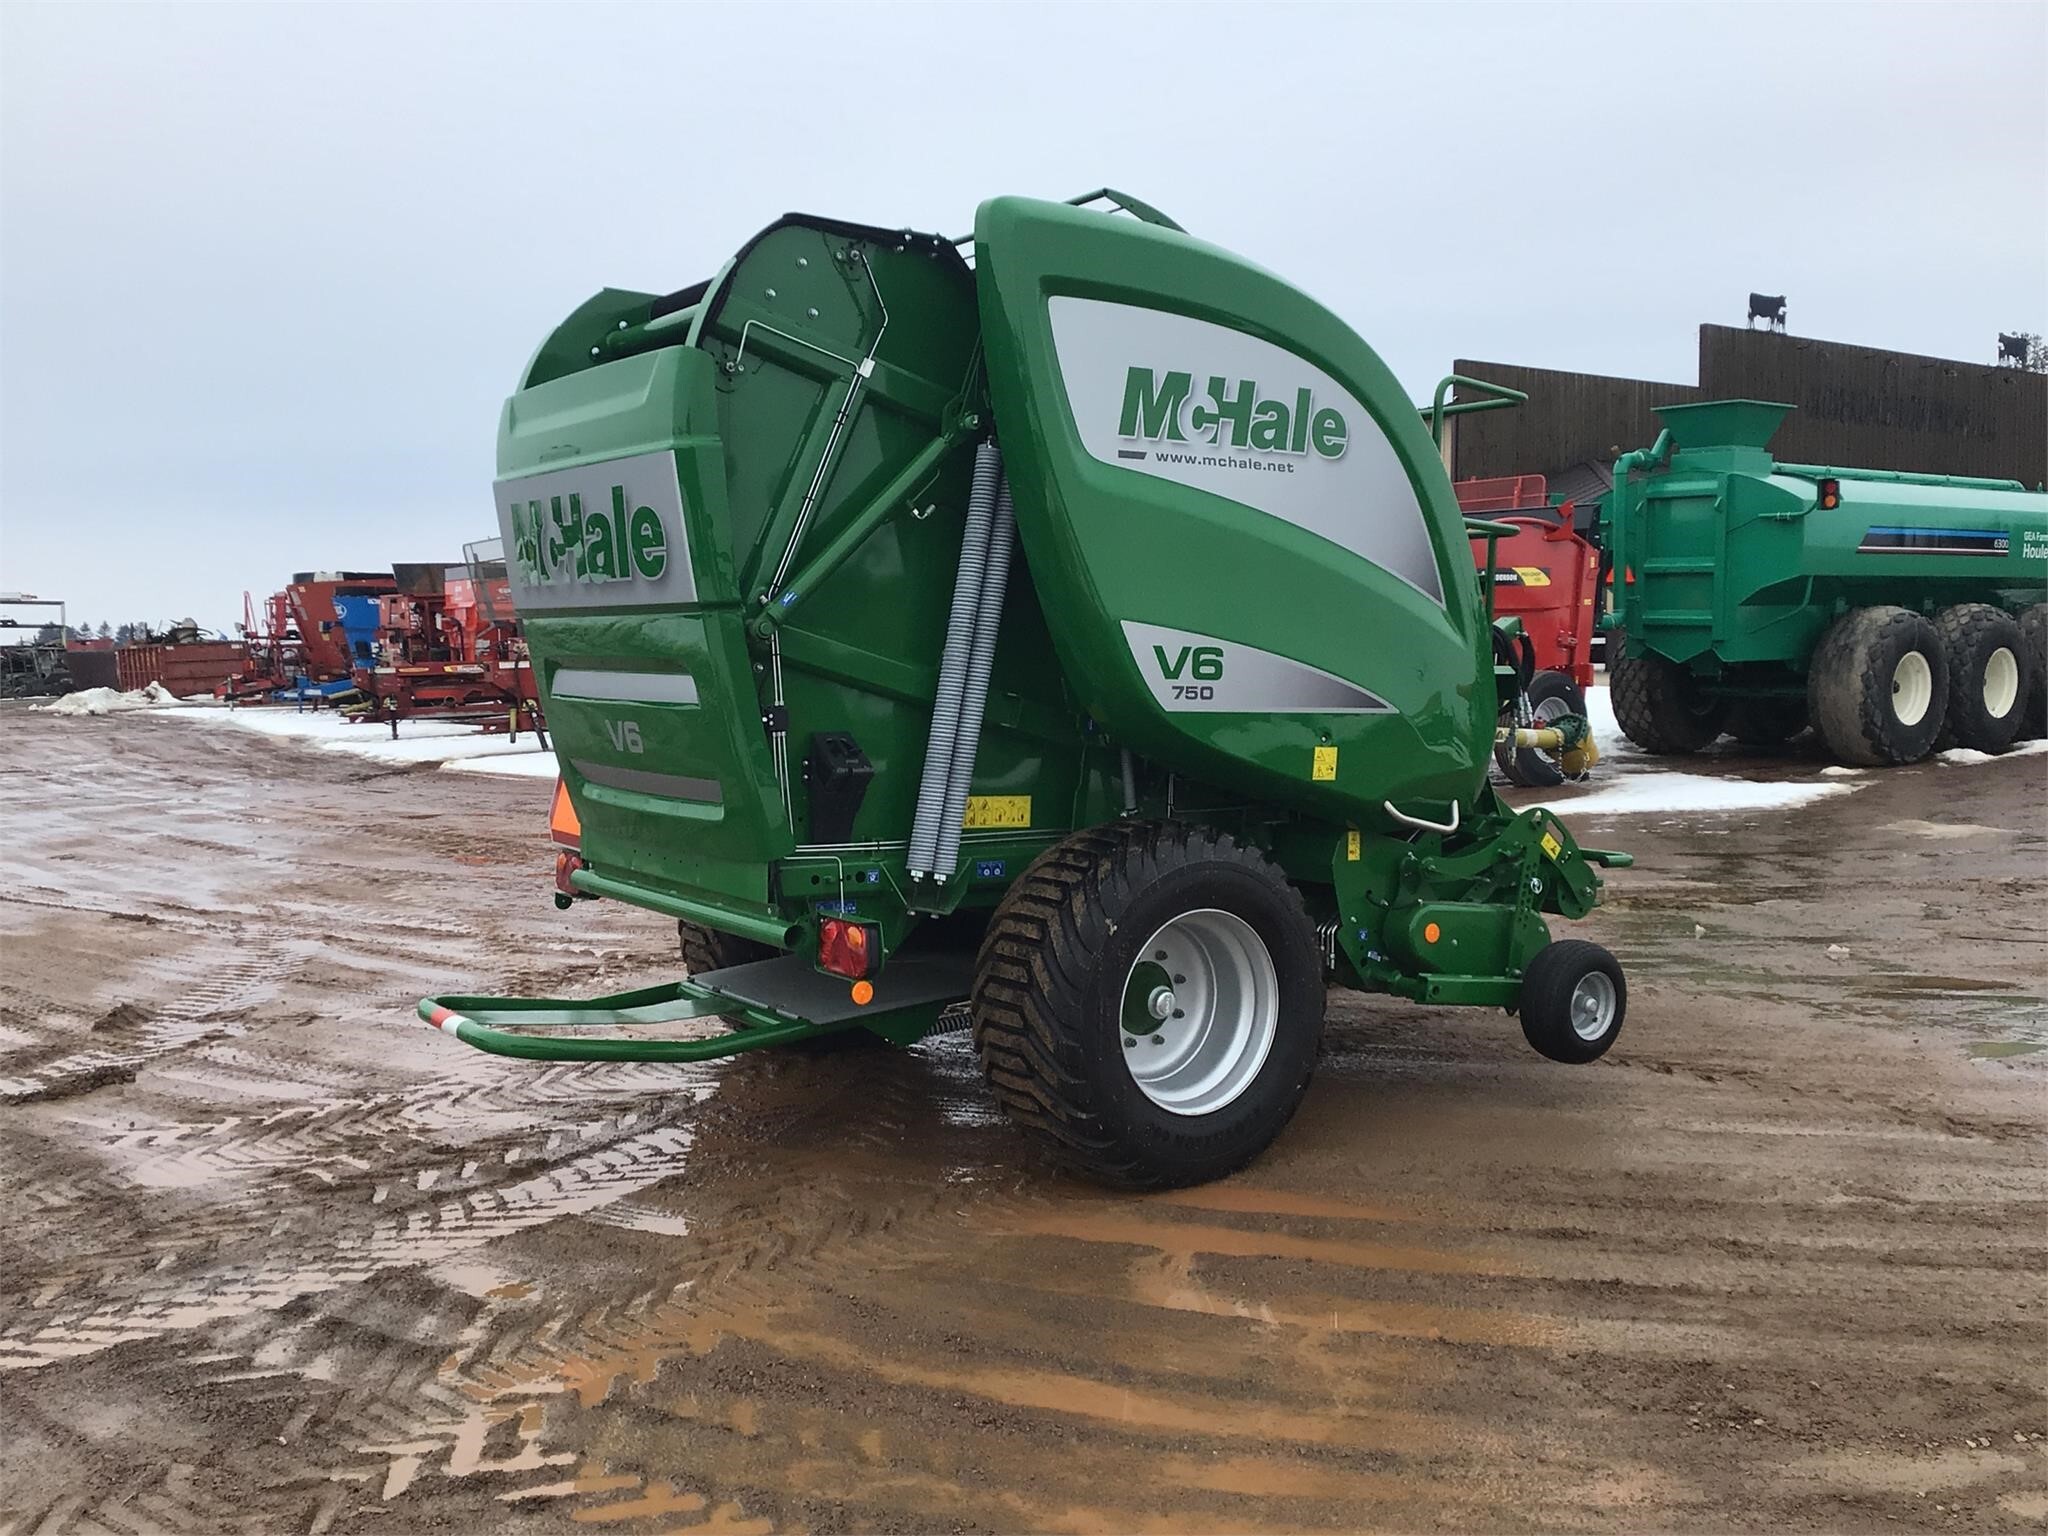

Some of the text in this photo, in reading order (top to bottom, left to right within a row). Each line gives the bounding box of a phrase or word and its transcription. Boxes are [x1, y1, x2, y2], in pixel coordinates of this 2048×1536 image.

[1117, 365, 1348, 459] McHale
[1155, 451, 1295, 473] www.mchale.net
[510, 484, 667, 583] McHale
[1993, 538, 2009, 548] 6300
[1152, 645, 1224, 681] V6
[1171, 685, 1214, 701] 750
[604, 718, 644, 754] V6
